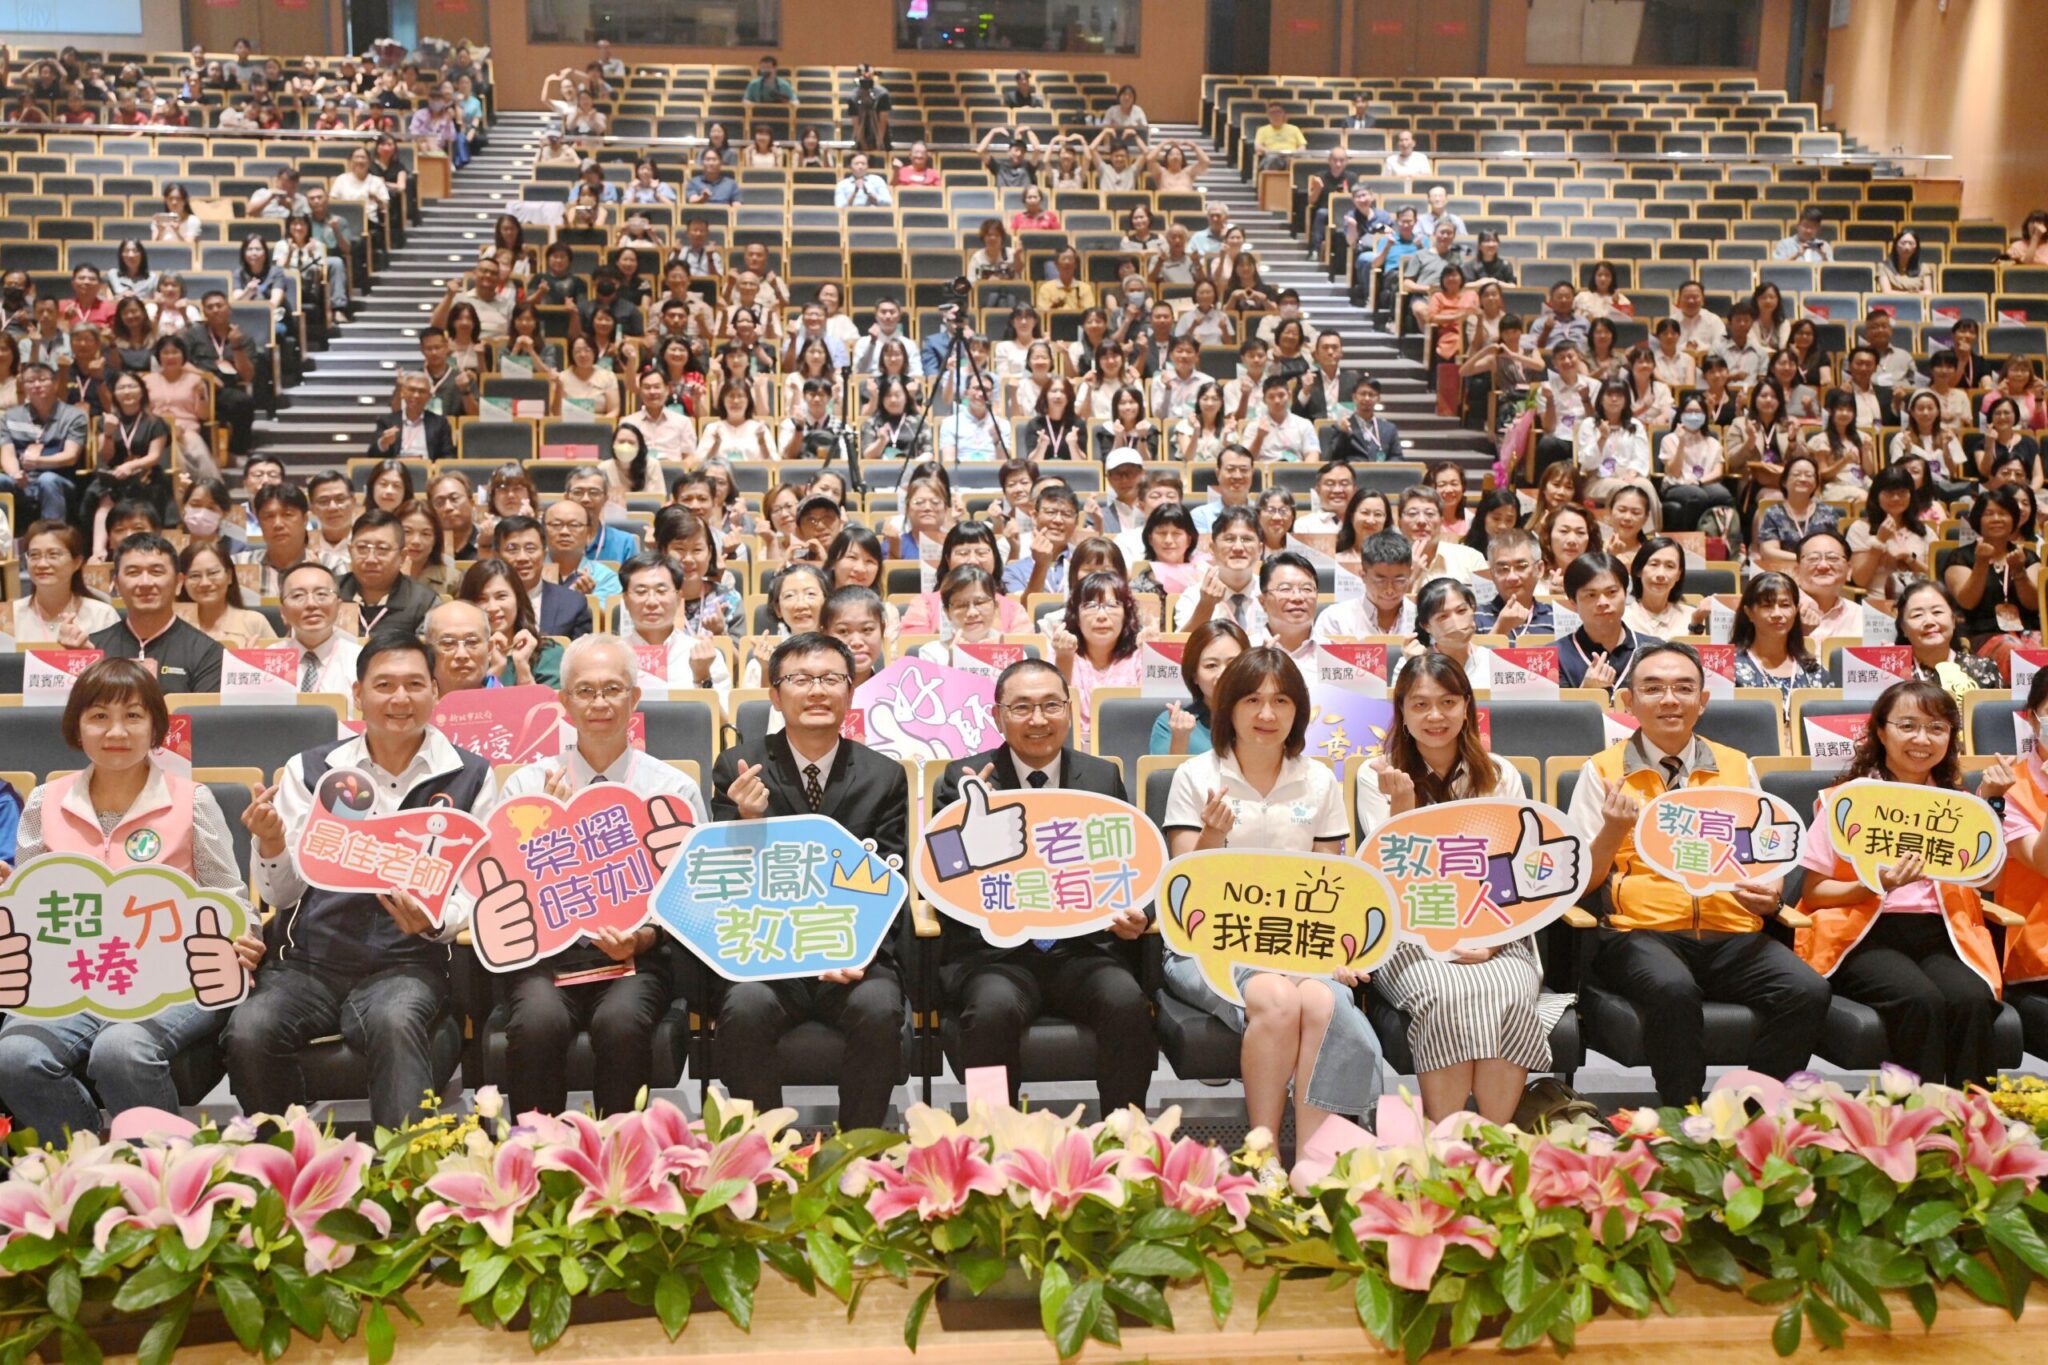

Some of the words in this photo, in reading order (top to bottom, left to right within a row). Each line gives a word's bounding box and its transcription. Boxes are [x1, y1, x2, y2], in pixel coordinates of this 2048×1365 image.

[28, 674, 65, 688] 貴賓席
[226, 672, 261, 685] 貴賓席
[1146, 665, 1178, 679] 貴賓席
[1322, 667, 1353, 680] 貴賓席
[1494, 671, 1526, 685] 貴賓席
[1847, 669, 1878, 683] 貴賓席
[450, 710, 493, 722] 新北市政府
[1814, 741, 1851, 757] 貴賓席
[1657, 803, 1736, 842] 教育
[1875, 804, 1920, 827] NO:1
[304, 820, 451, 894] 最佳老師
[519, 805, 638, 880] 榮耀
[1035, 814, 1132, 864] 老師
[1380, 835, 1489, 879] 教育
[1673, 839, 1749, 879] 達人
[1865, 828, 1953, 868] 我最棒
[540, 849, 655, 930] 時刻
[688, 843, 826, 901] 奉獻
[979, 863, 1139, 910] 就是有才
[1224, 882, 1286, 909] NO:1
[1404, 882, 1513, 928] 達人
[715, 905, 859, 962] 教育
[1213, 913, 1337, 961] 我最棒
[67, 936, 139, 995] 棒
